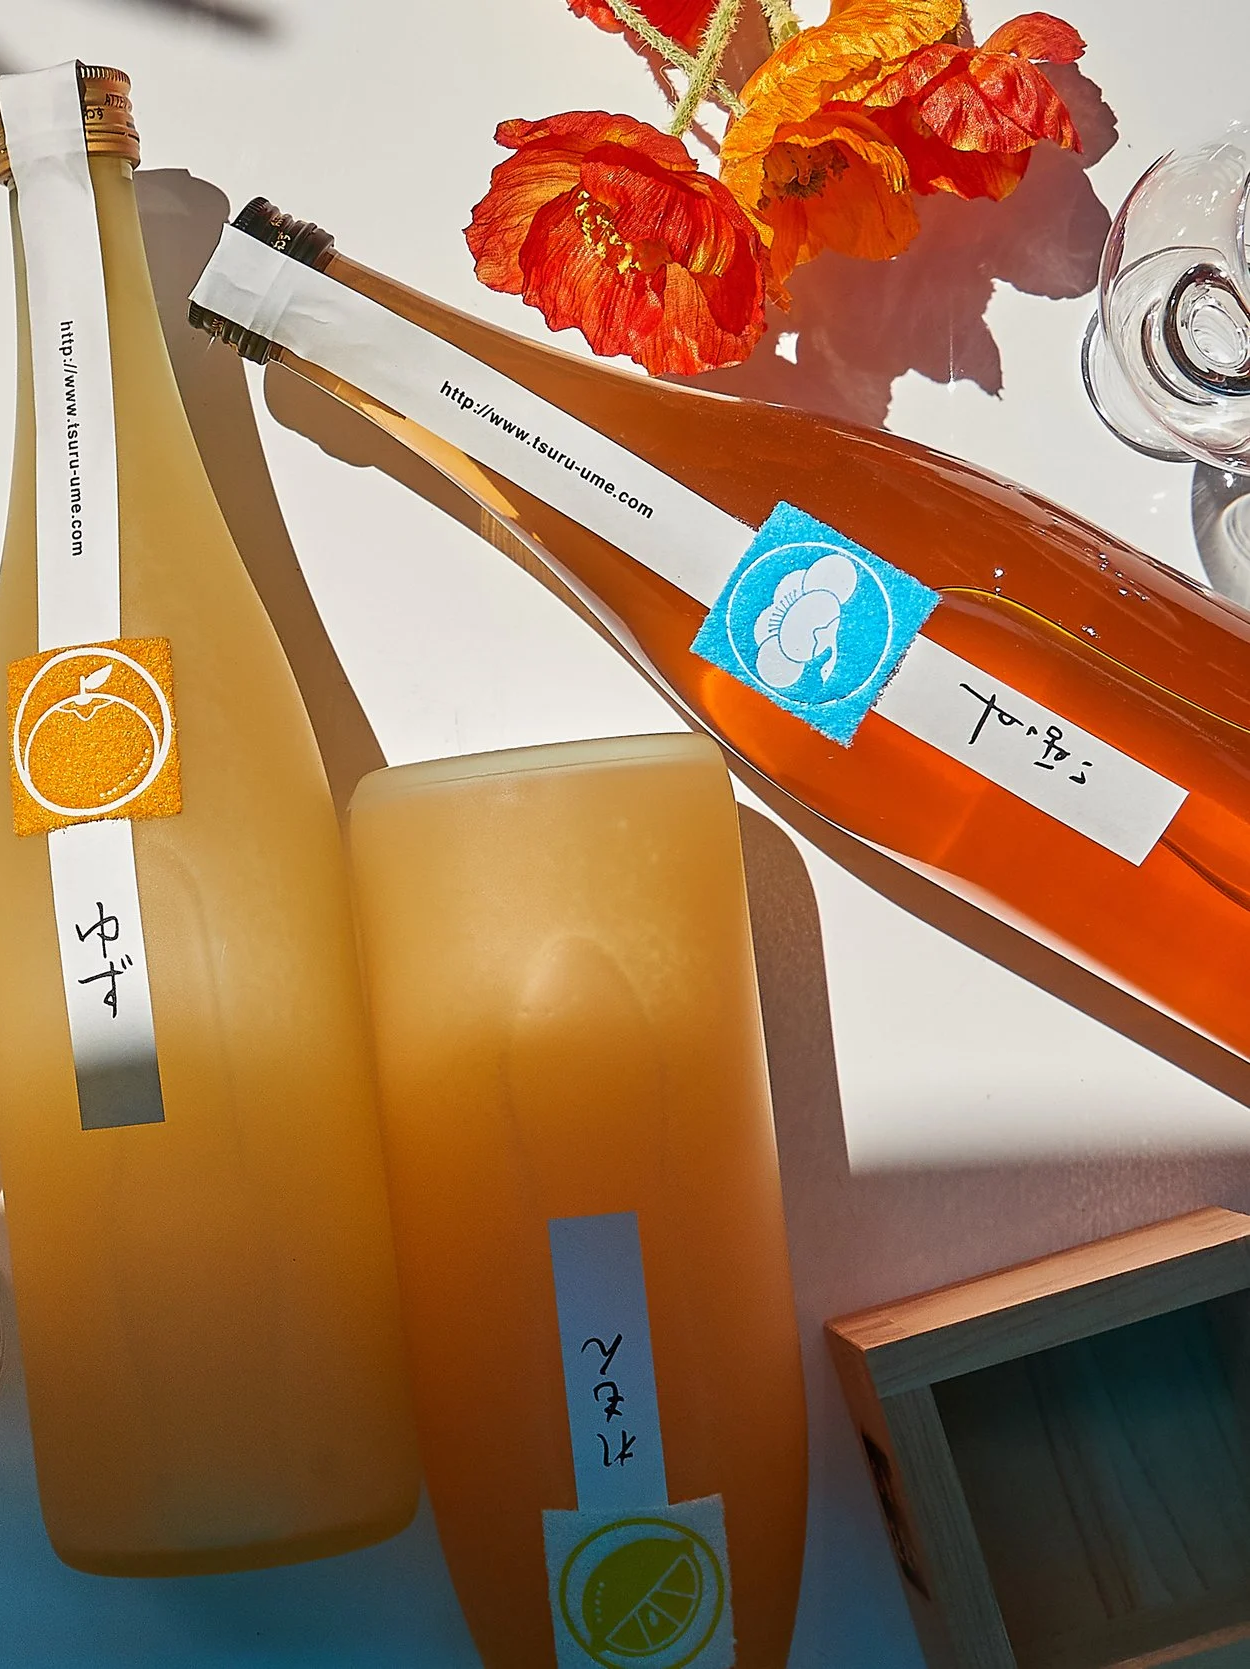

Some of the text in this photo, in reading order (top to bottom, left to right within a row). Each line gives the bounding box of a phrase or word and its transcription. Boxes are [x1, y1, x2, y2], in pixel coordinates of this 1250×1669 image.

[59, 320, 83, 556] http://www.tsuru-ume.com
[440, 380, 654, 519] http://www.tsuru-ume.com
[959, 683, 1093, 785] すっぱい
[75, 902, 133, 1018] ゆず
[581, 1333, 636, 1467] れもん
